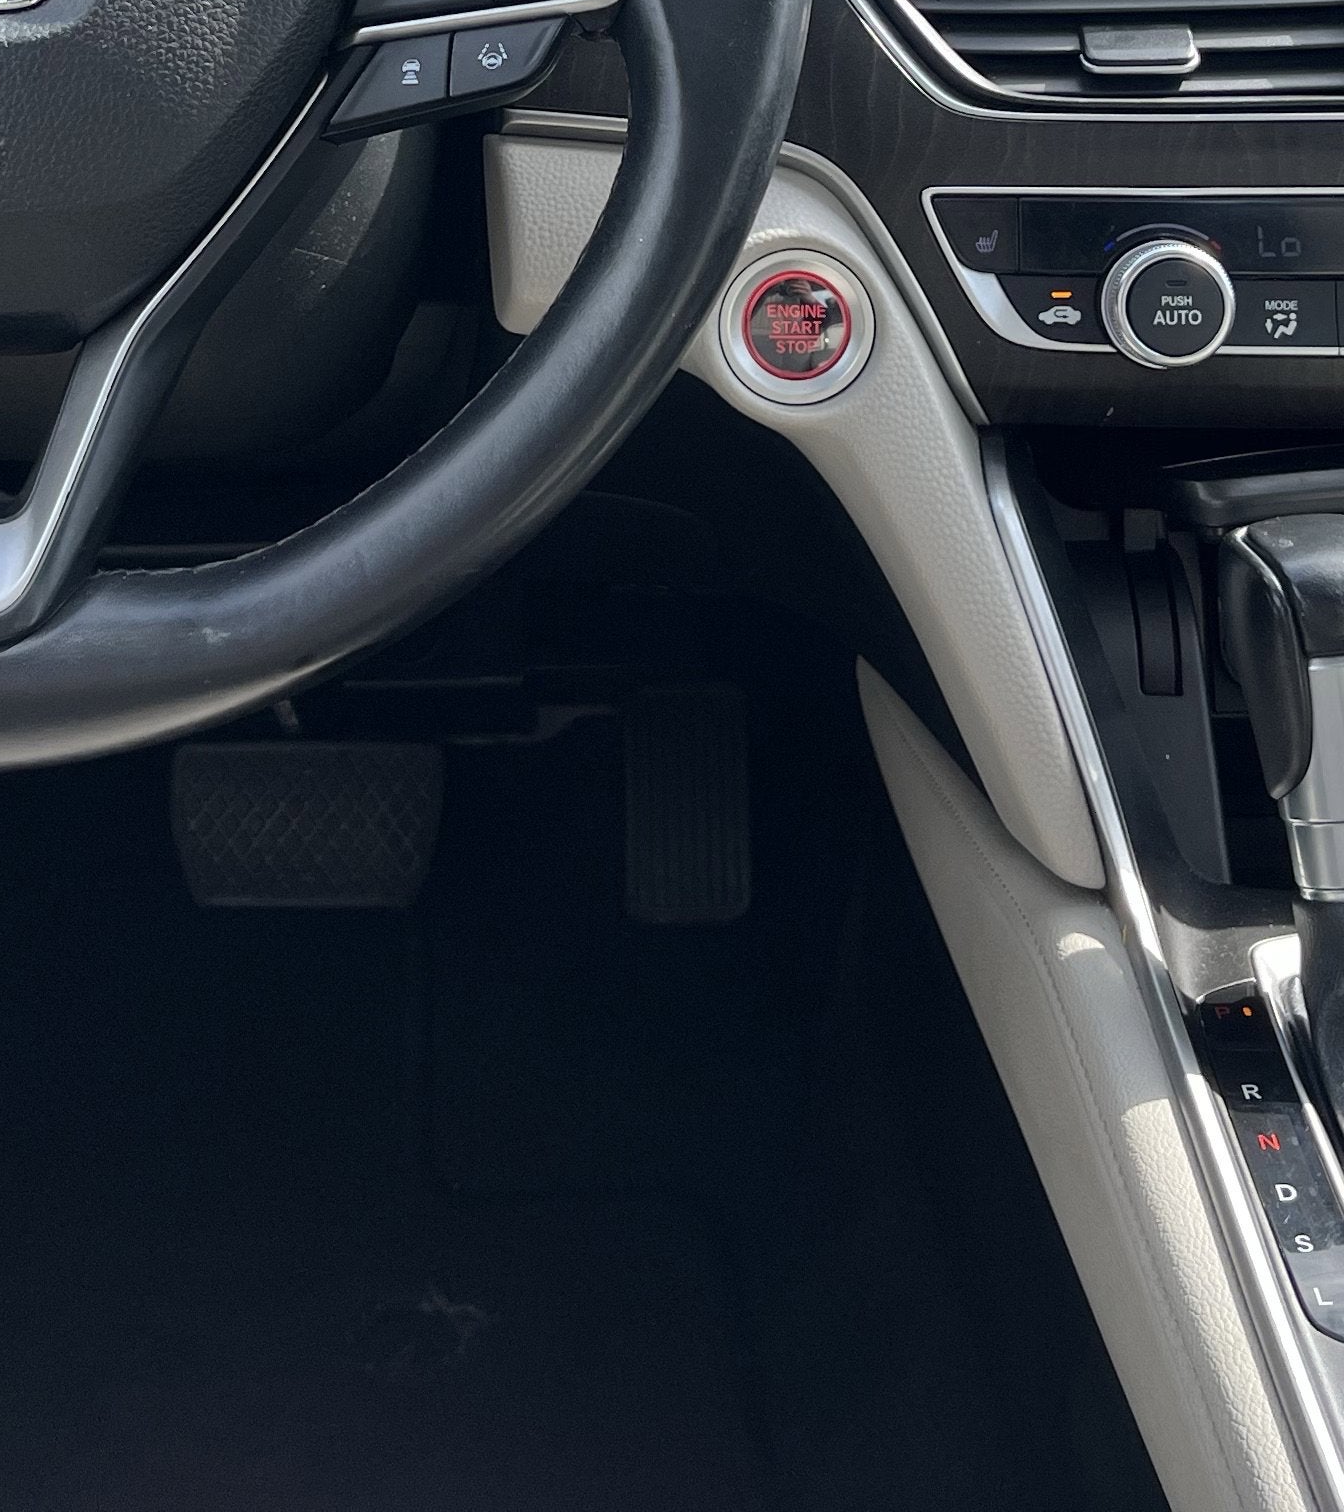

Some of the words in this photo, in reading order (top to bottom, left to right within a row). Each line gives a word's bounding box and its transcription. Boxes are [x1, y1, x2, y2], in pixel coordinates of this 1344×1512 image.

[1258, 225, 1302, 258] Lo
[1161, 295, 1193, 307] PUSH
[1264, 299, 1299, 312] MODE
[766, 304, 827, 319] ENGINE
[1153, 308, 1203, 326] AUTO
[771, 320, 823, 335] START
[775, 340, 817, 354] STOP
[1241, 1083, 1263, 1101] R
[1257, 1132, 1281, 1151] N
[1274, 1183, 1298, 1202] D
[1293, 1234, 1314, 1253] S
[1312, 1286, 1334, 1307] L
